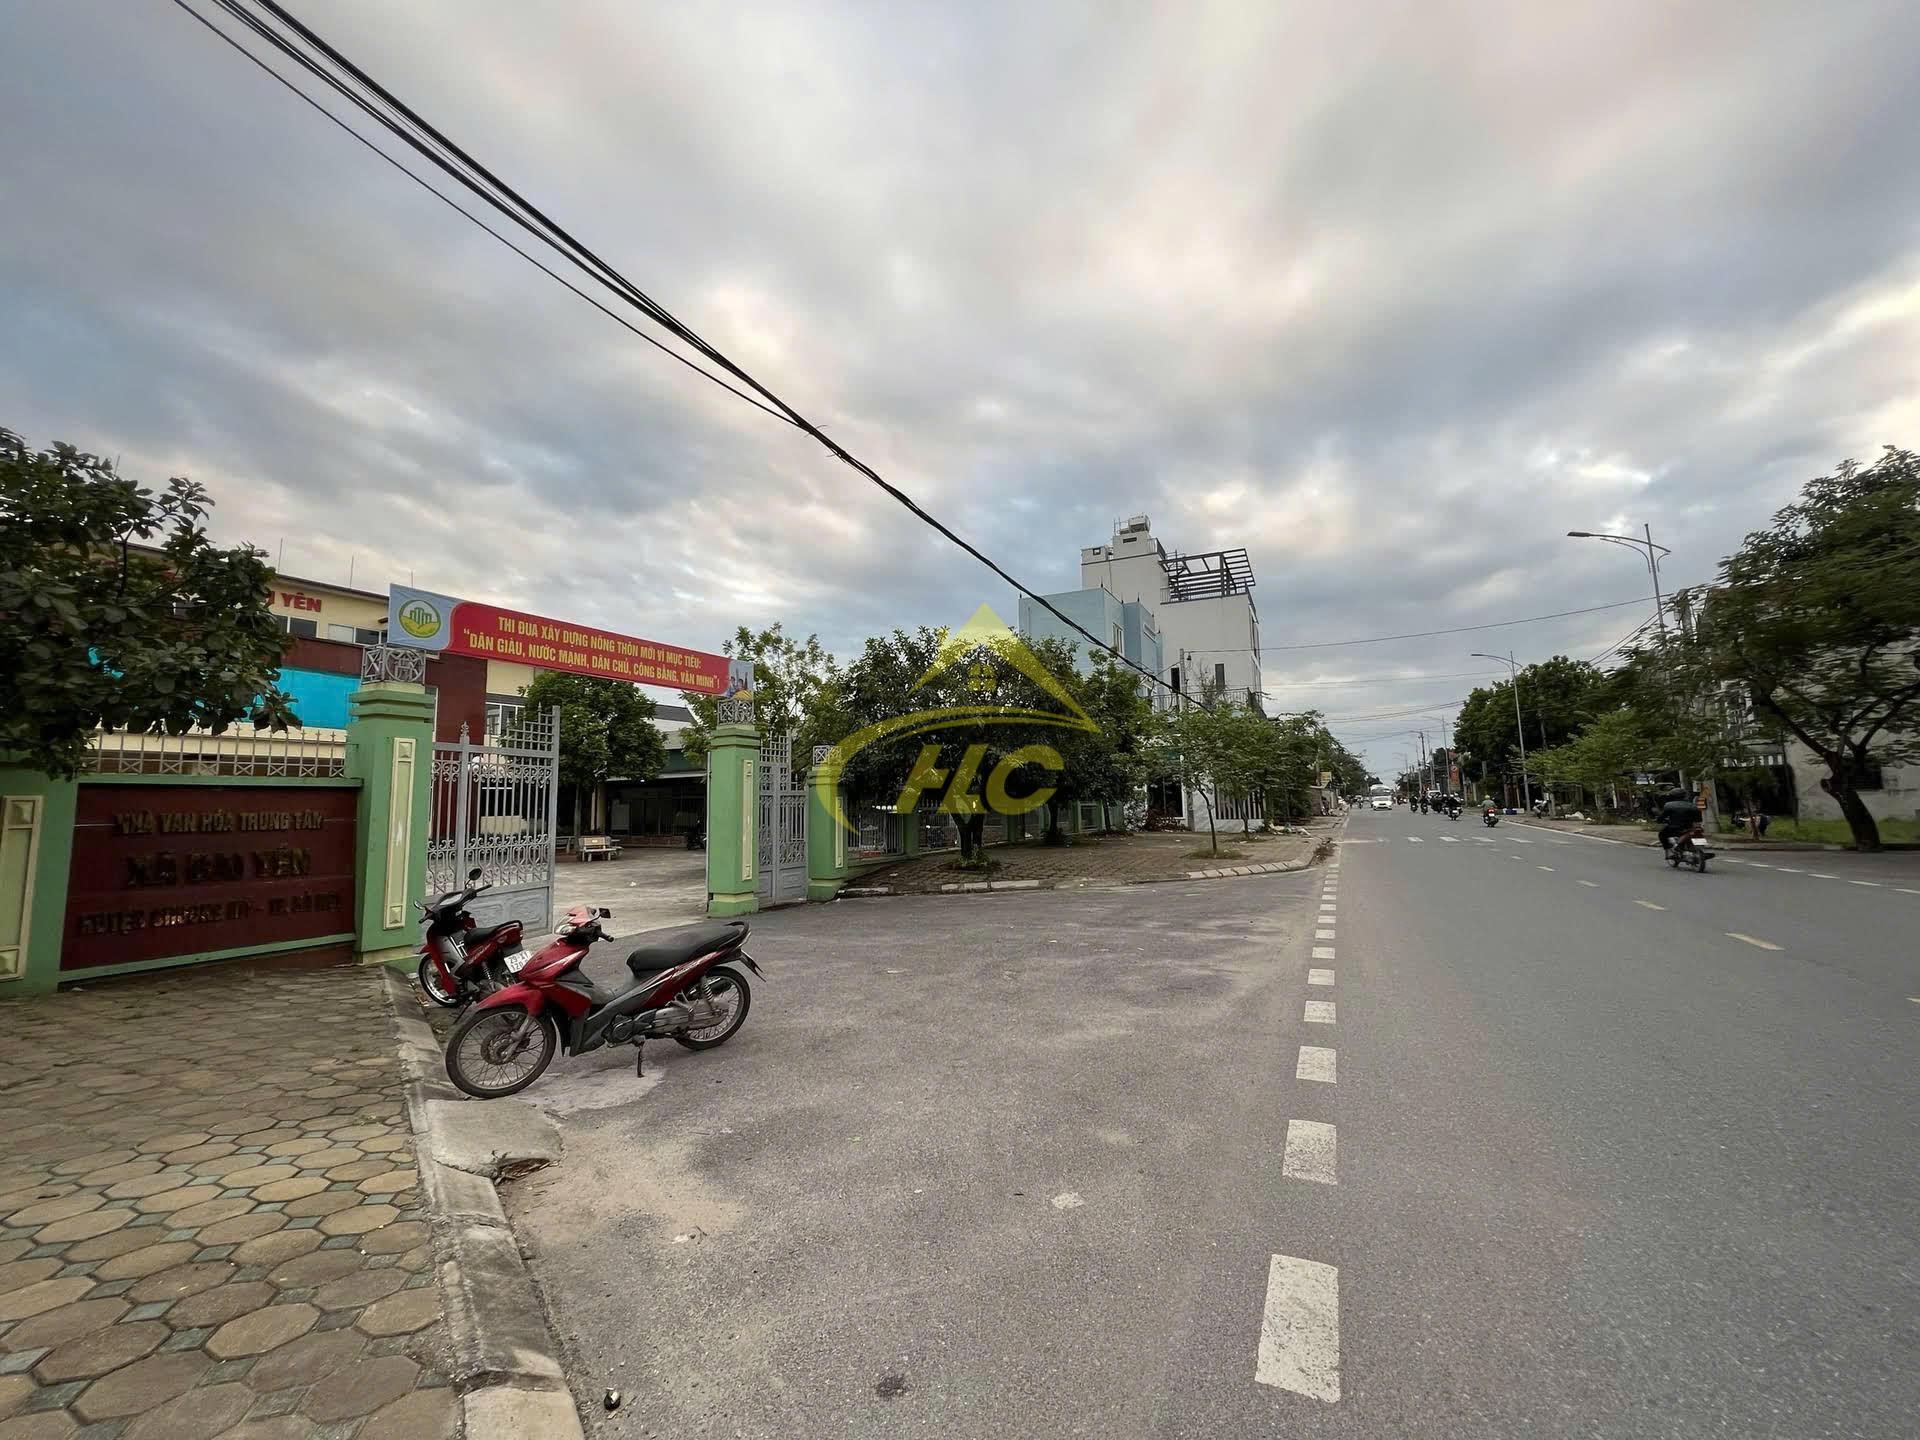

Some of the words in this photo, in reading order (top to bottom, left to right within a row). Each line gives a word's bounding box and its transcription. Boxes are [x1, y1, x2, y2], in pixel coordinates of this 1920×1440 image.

[281, 592, 322, 612] YÊN
[498, 616, 514, 634] THI
[518, 621, 538, 638] ĐUA
[542, 624, 560, 642] XÂY
[563, 630, 588, 648] DỰNG
[590, 635, 615, 652] NÔNG
[617, 640, 639, 657] THÔN
[497, 638, 526, 658] GIÀU,
[528, 644, 556, 662] NƯỚC
[559, 650, 590, 668] MẠNH,
[592, 654, 610, 670] DÂN
[634, 663, 655, 678] CÔNG
[240, 811, 289, 832] TRUNG
